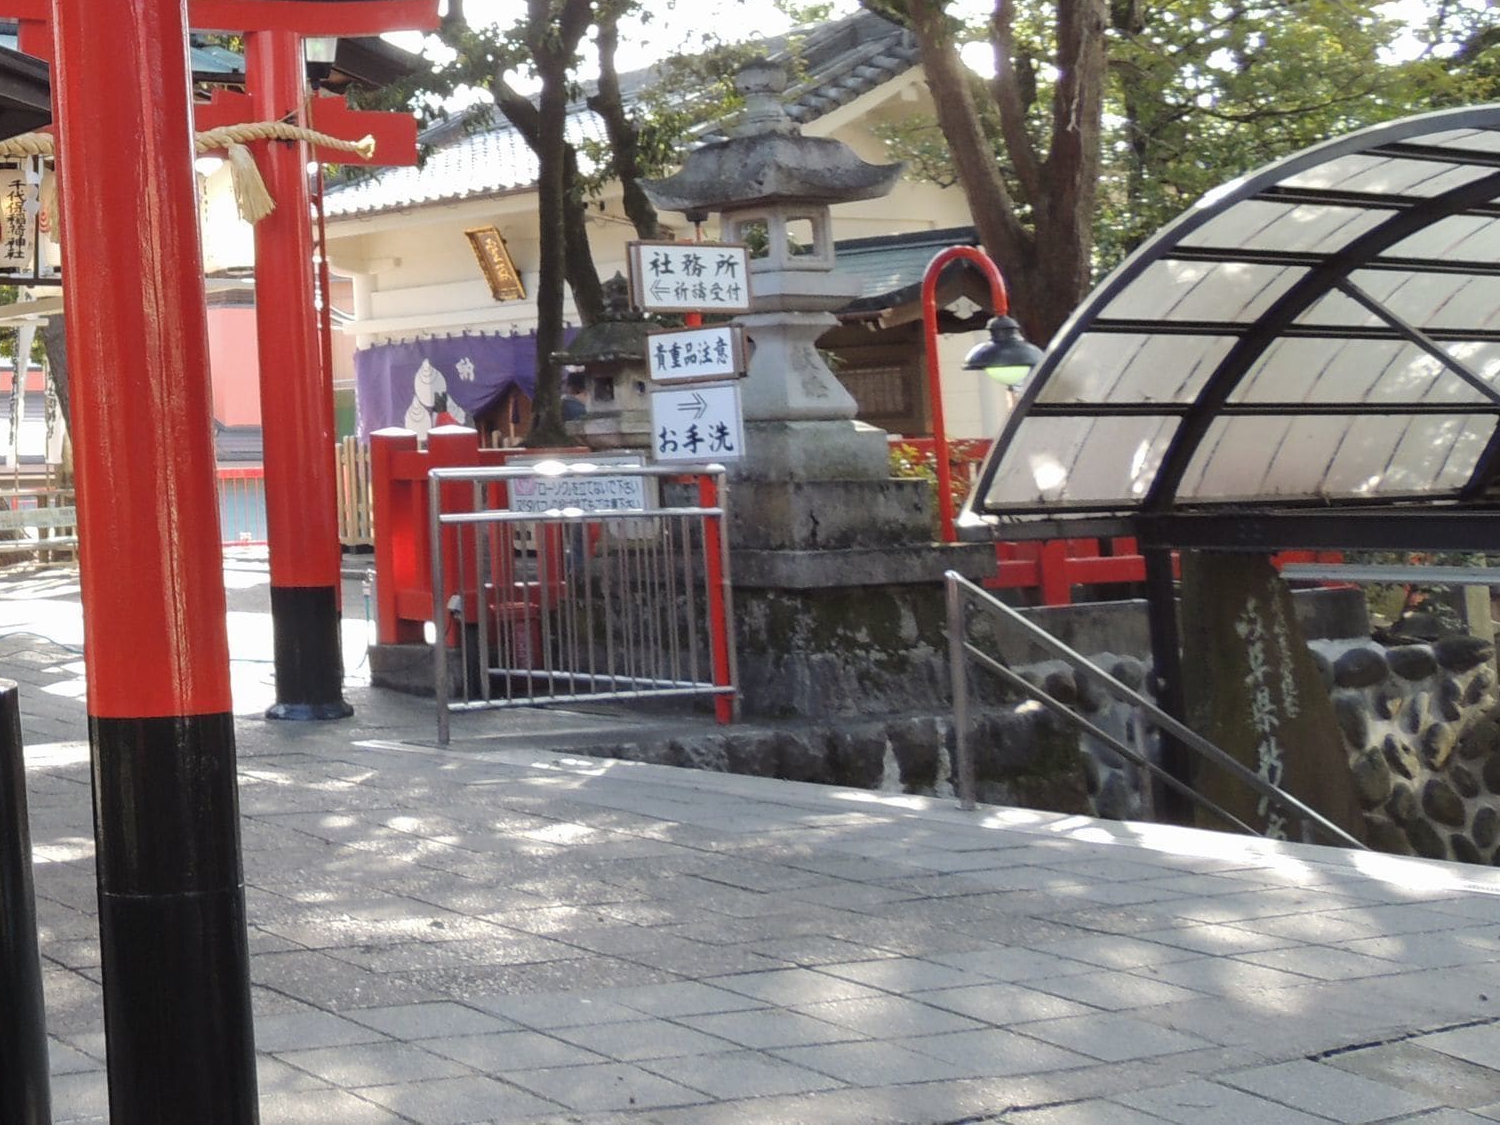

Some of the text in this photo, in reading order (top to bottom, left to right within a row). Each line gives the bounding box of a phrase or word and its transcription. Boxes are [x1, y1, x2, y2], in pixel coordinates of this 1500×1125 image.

[649, 251, 740, 279] 社務所
[654, 336, 730, 371] 貴重品注意
[658, 421, 735, 455] お手洗
